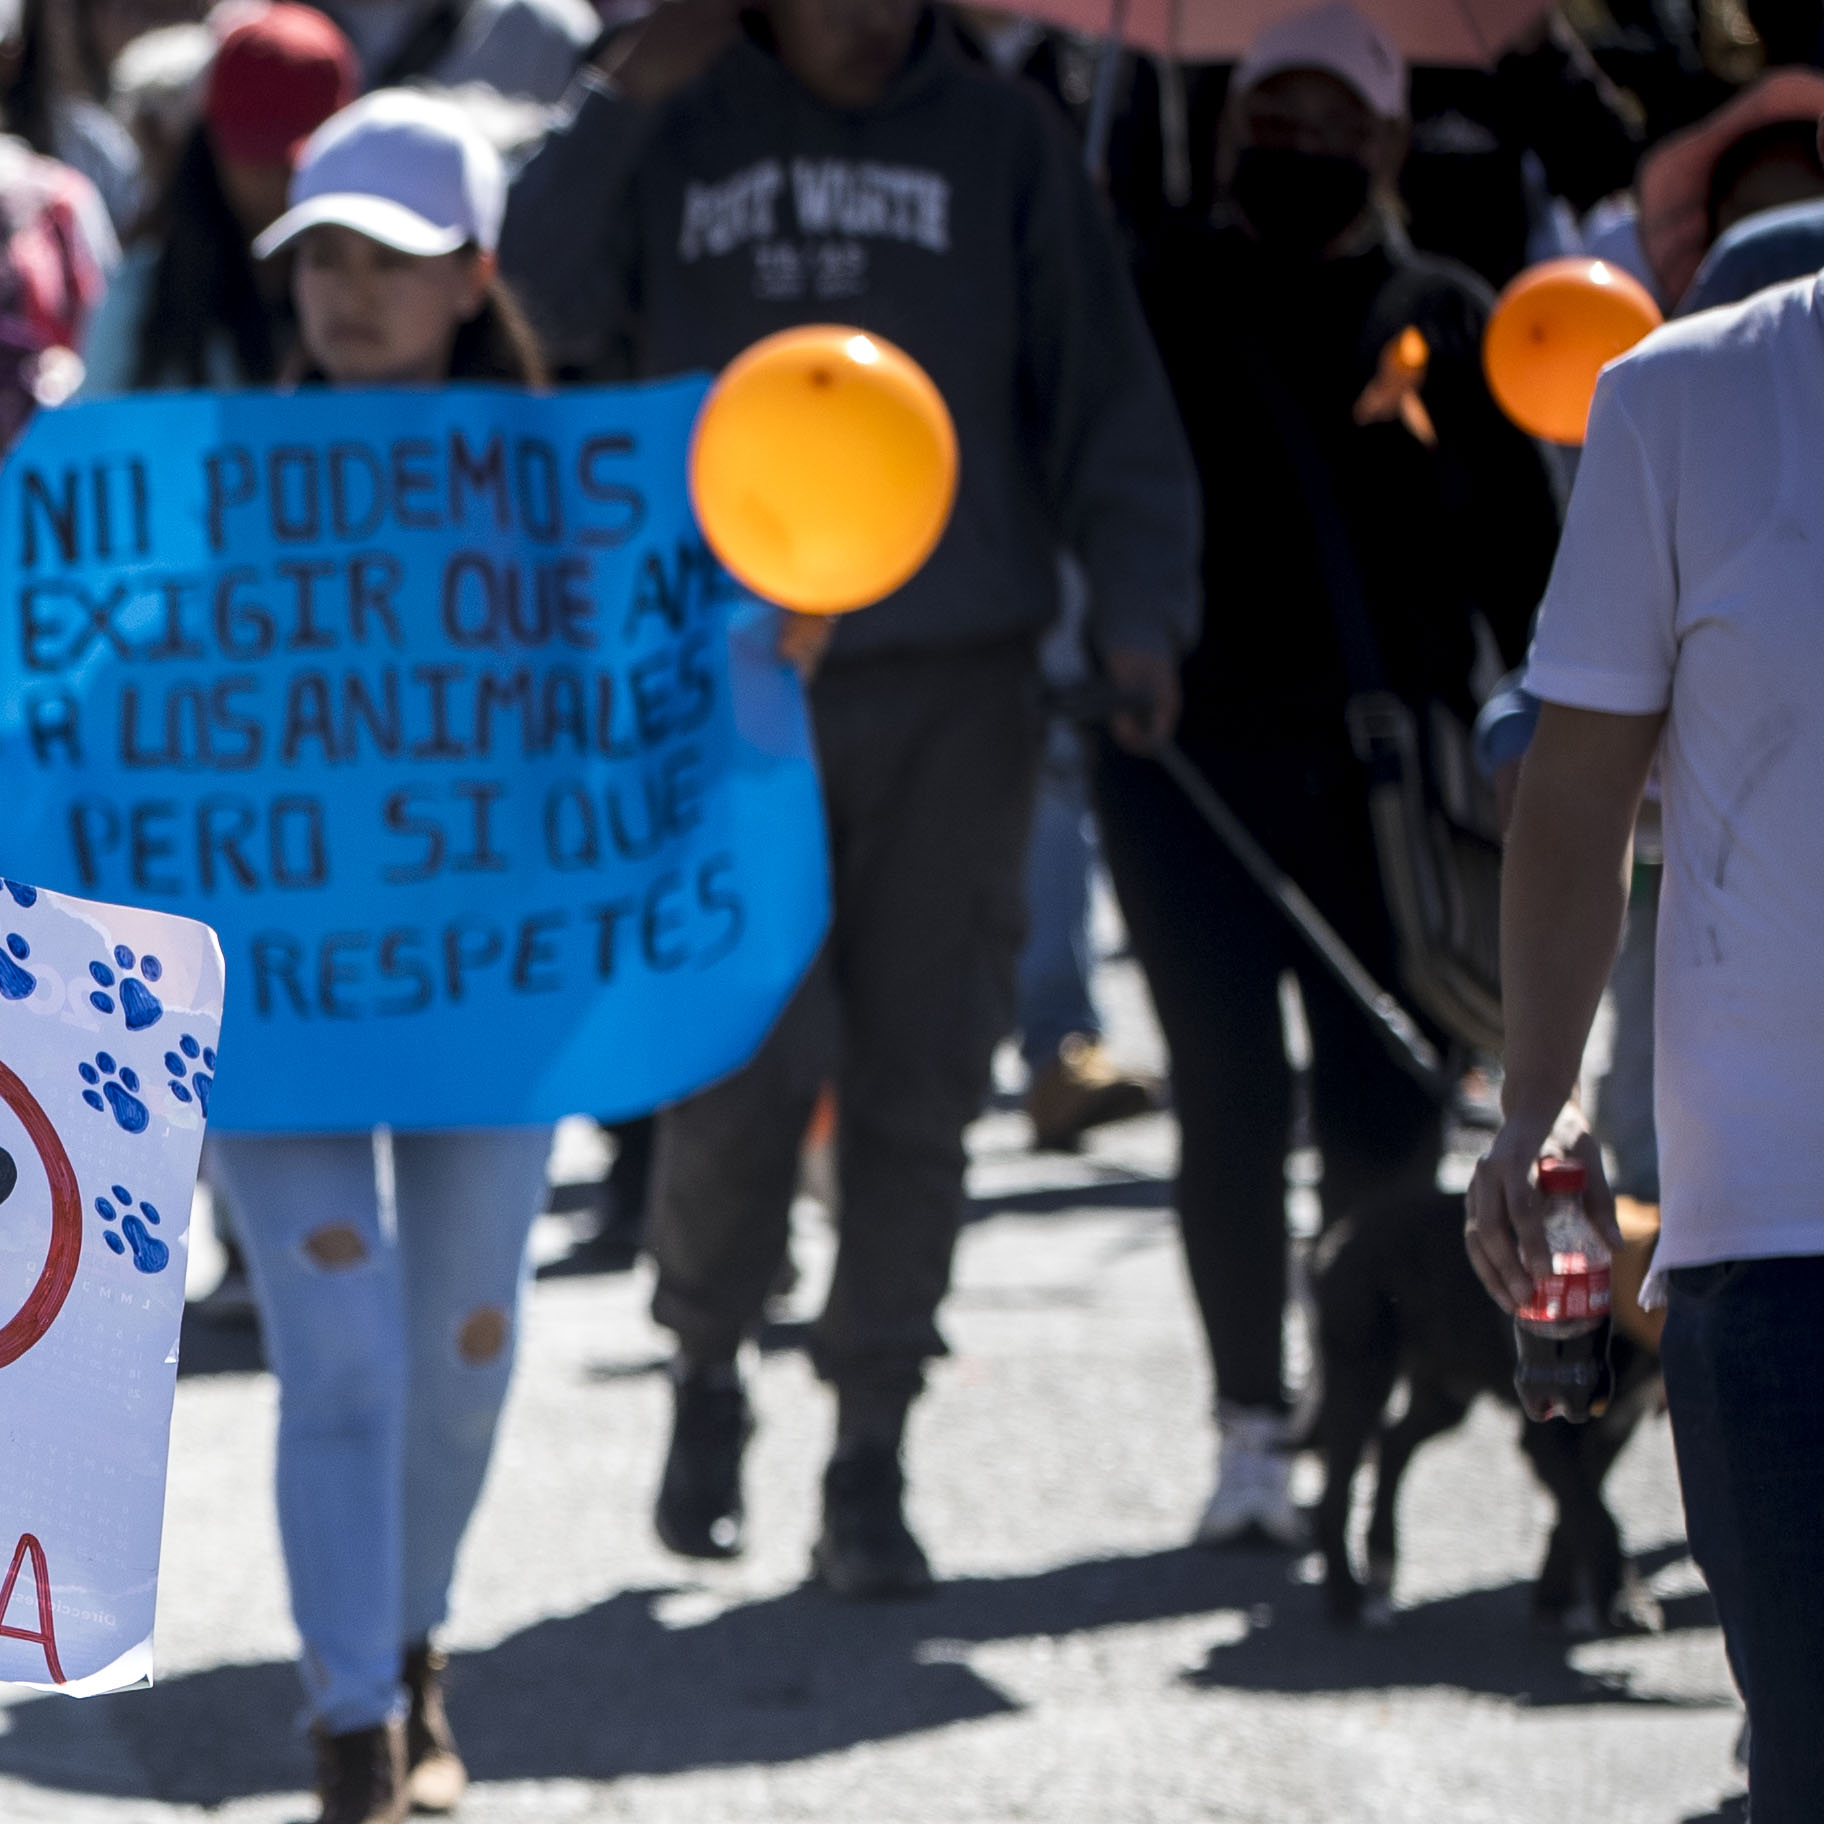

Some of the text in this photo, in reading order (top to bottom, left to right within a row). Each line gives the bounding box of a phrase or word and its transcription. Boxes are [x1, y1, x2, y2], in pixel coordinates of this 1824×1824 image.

[204, 428, 646, 553] PODEMOS
[18, 549, 407, 674] EXIGIR
[440, 547, 600, 653] QUE
[282, 637, 716, 772] ANIMALES
[67, 747, 709, 899] PERO SI QUE
[250, 850, 748, 1022] RESPETES
